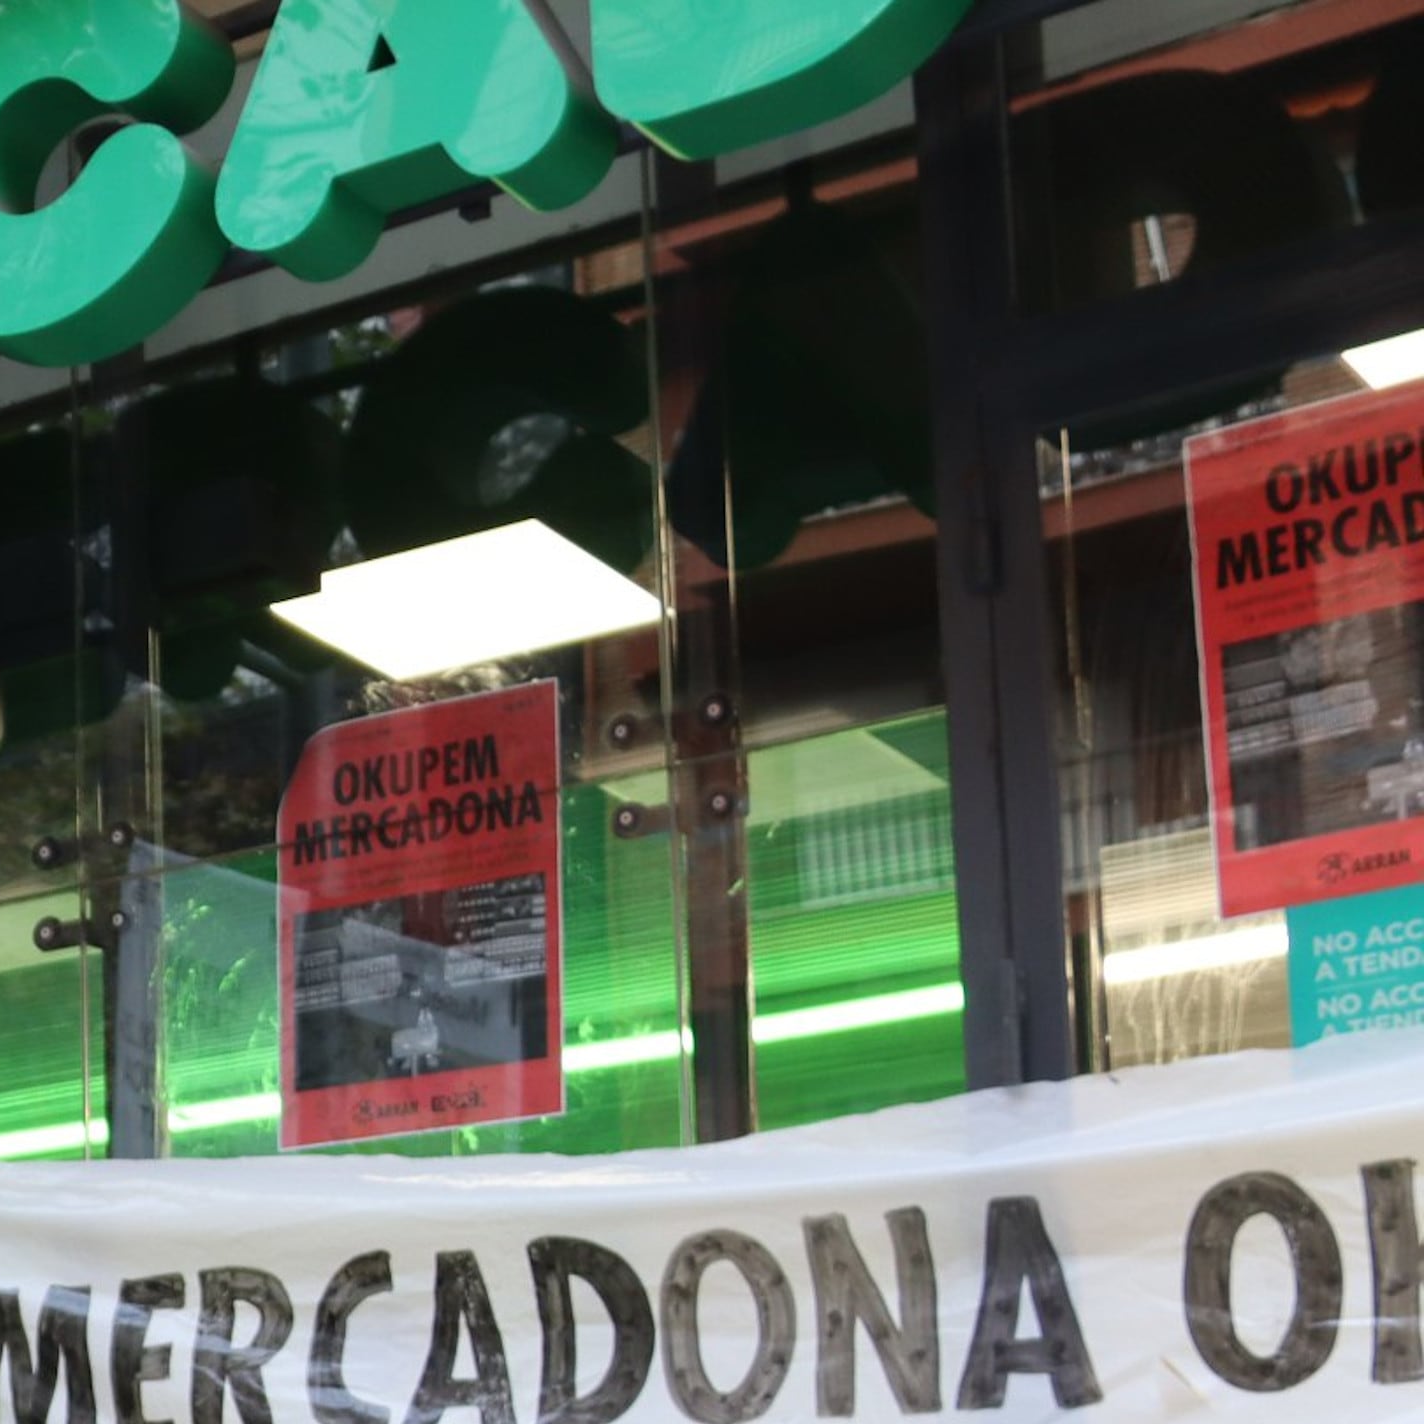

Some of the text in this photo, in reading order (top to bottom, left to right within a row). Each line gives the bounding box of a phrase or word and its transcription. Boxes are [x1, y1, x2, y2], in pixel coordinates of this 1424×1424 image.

[1265, 426, 1424, 514] OKUP
[333, 733, 499, 806] OKUPEM
[293, 780, 543, 866] MERCADONA
[1313, 930, 1357, 957] NO
[1315, 945, 1424, 983] A TEND
[1318, 993, 1363, 1020] NO
